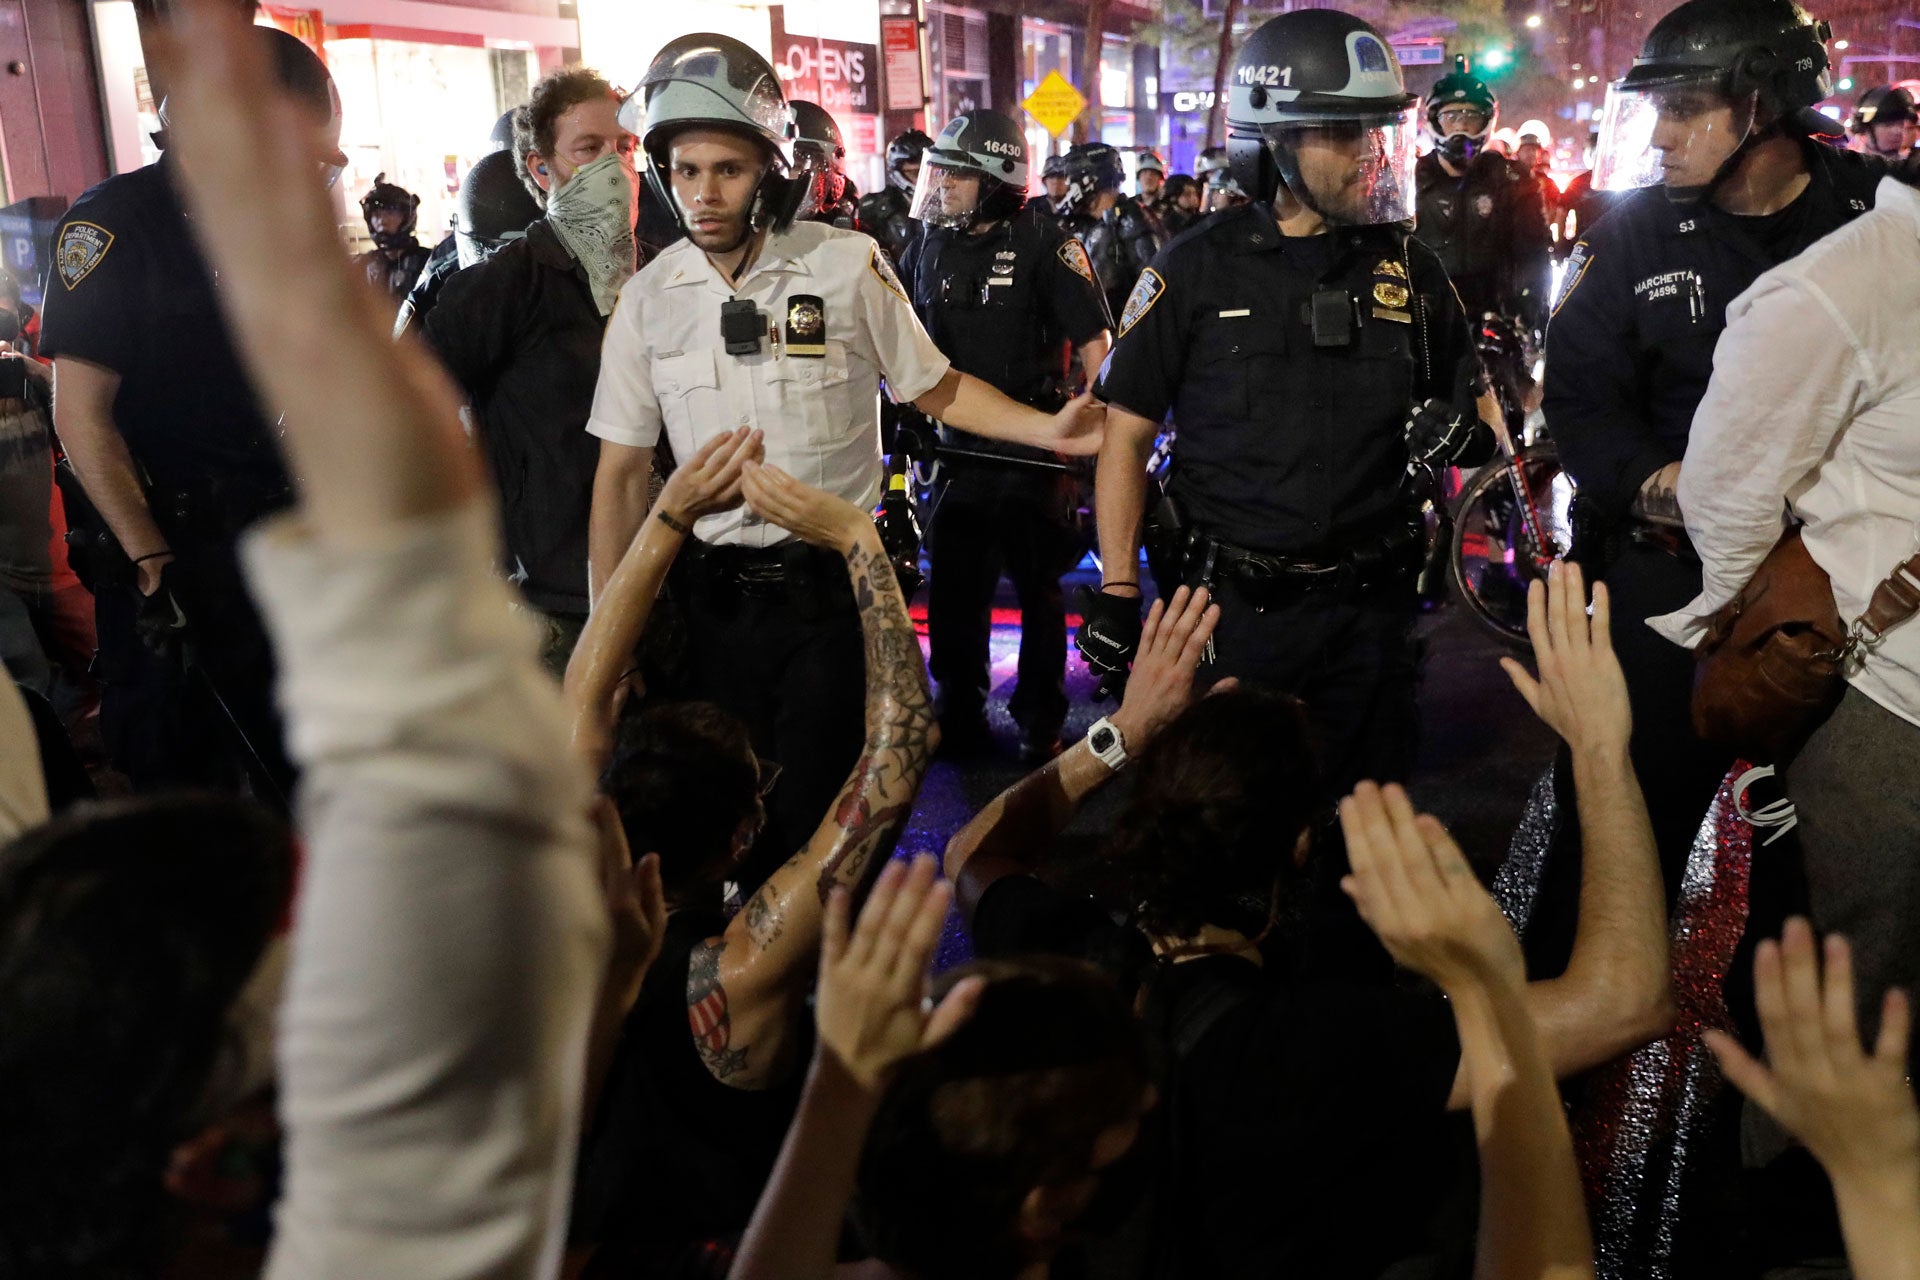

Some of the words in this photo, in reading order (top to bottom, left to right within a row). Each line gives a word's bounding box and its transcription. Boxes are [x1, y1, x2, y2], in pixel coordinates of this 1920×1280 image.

[786, 44, 866, 83] OHEN'S
[1795, 57, 1813, 71] 739
[1238, 66, 1292, 87] 10421
[984, 140, 1021, 157] 16430
[1850, 199, 1866, 211] S3
[75, 226, 98, 238] POLICE
[1679, 220, 1695, 232] S3
[65, 232, 104, 248] DEPARTMENT
[15, 238, 30, 265] P
[1634, 270, 1695, 296] MARCHETTA
[1648, 284, 1677, 301] 24596
